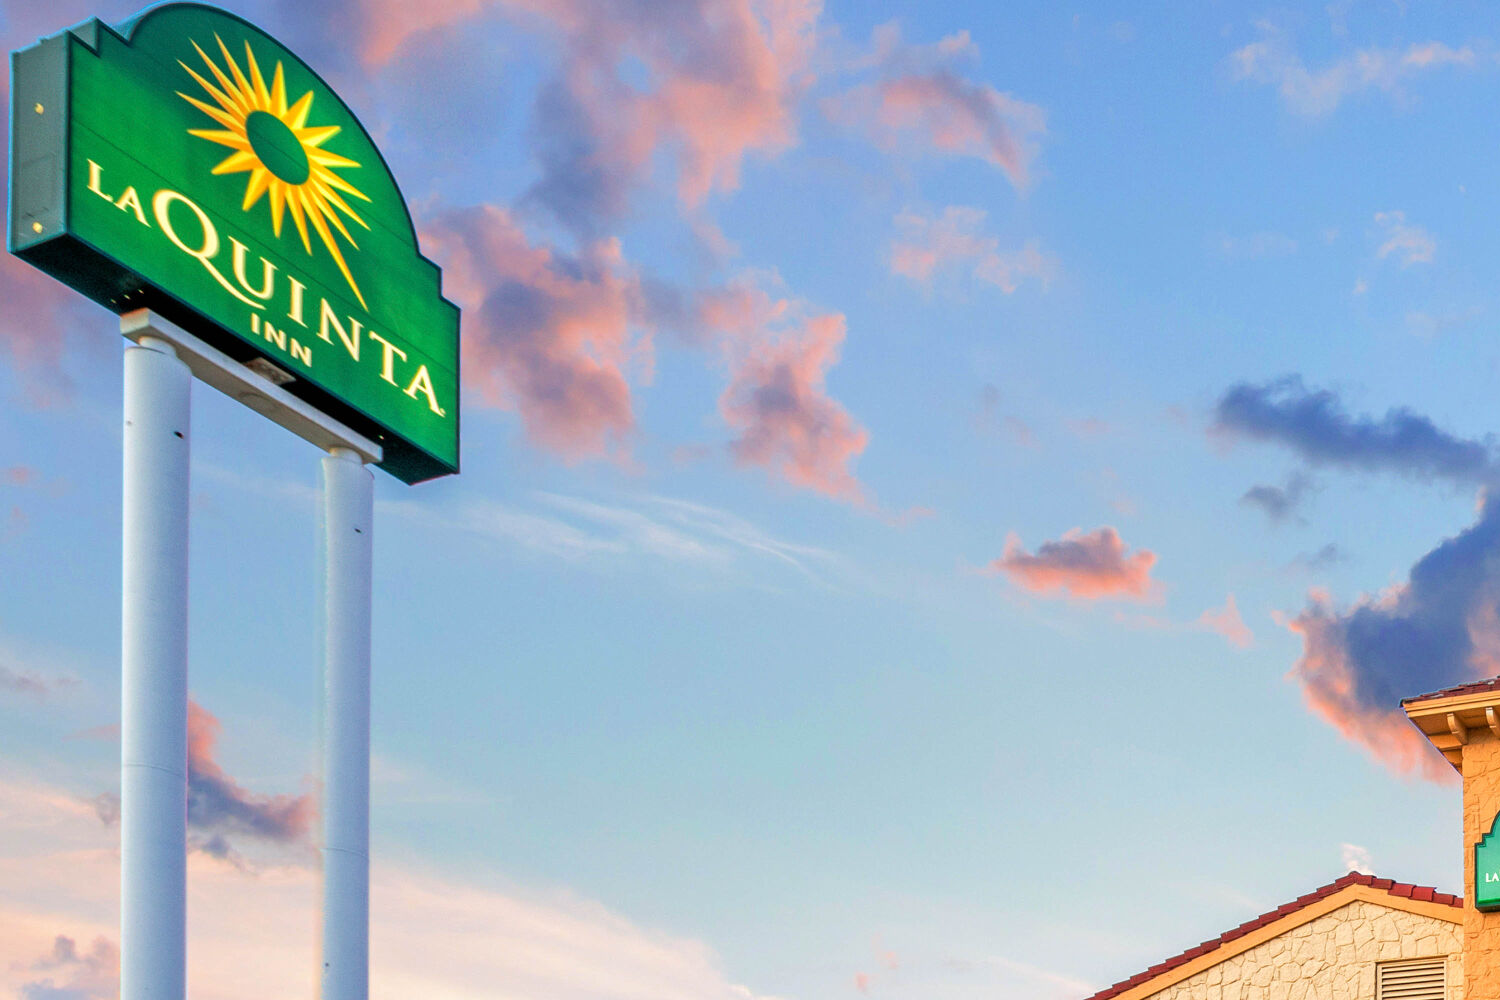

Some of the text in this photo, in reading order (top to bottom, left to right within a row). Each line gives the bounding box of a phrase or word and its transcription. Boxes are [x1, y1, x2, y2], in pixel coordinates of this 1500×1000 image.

[86, 159, 446, 418] LA QUINTA
[250, 313, 313, 368] INN
[1485, 872, 1499, 882] LA
